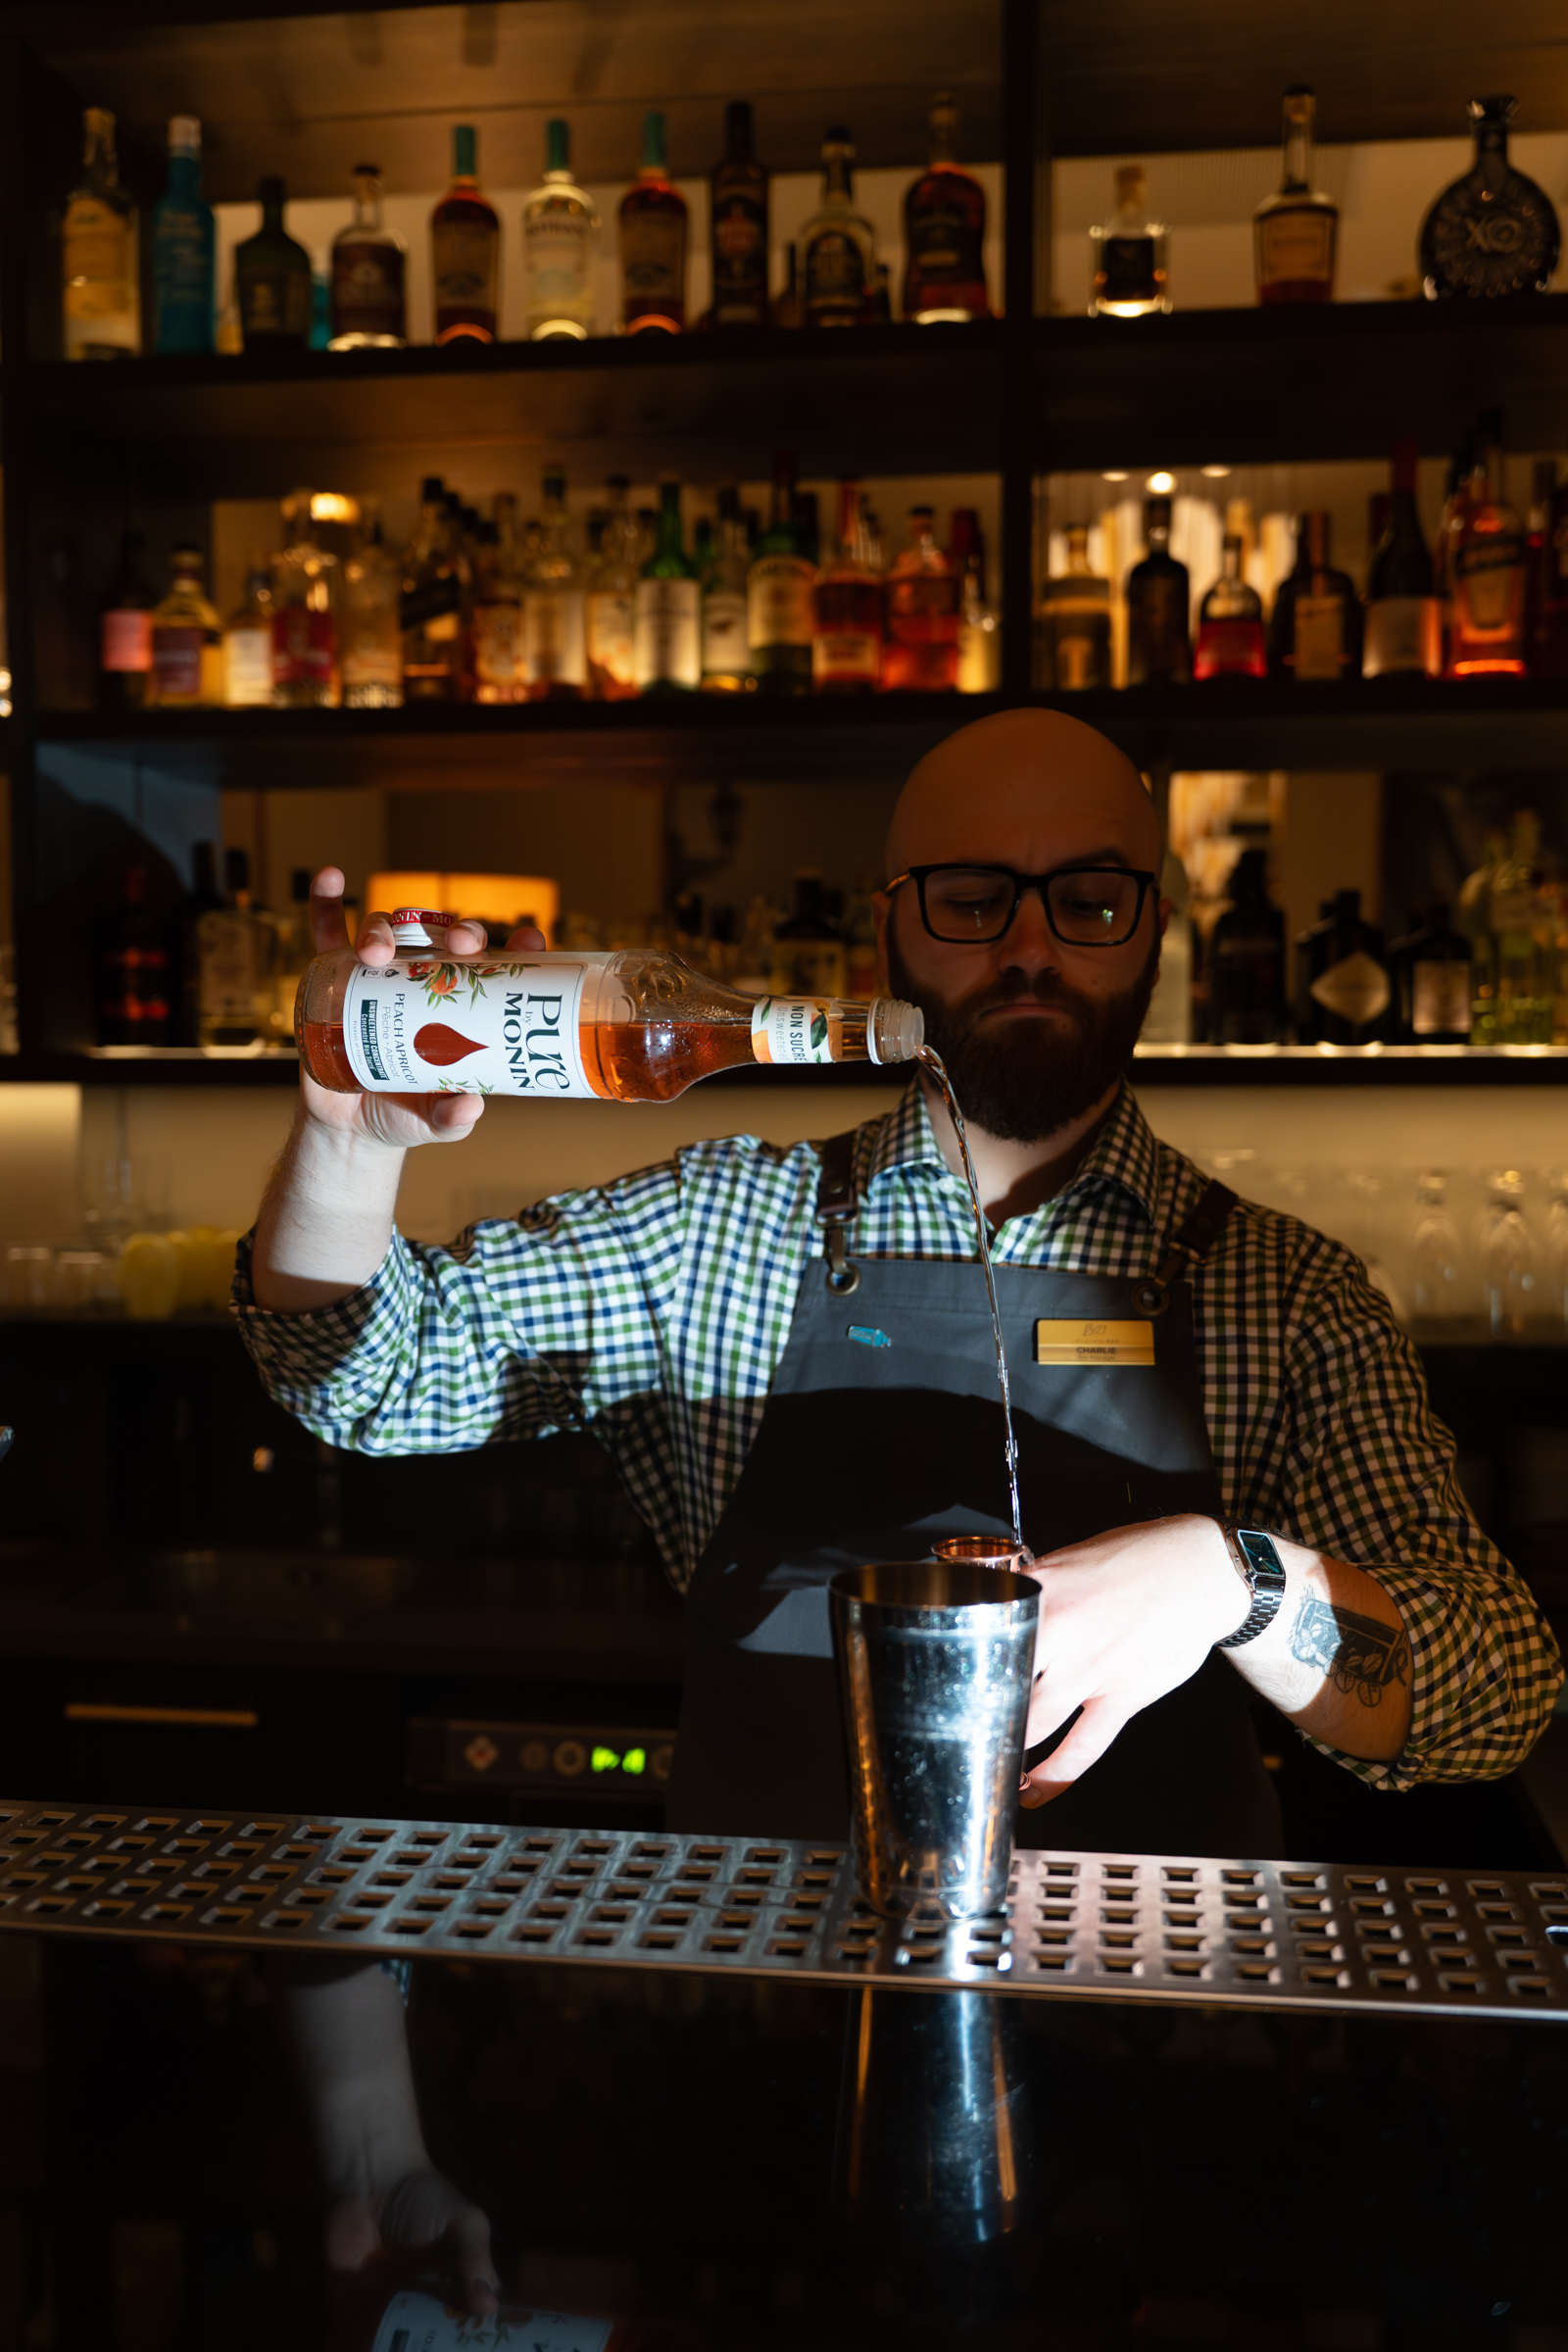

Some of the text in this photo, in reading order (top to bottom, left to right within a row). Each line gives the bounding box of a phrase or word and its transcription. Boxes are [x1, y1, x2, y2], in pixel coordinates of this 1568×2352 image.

[393, 911, 421, 923] ONIN
[368, 1001, 377, 1045] UNSWEETENED
[381, 1005, 400, 1077] Pêche Abricot
[393, 993, 418, 1085] PEACH APRICOT
[503, 992, 536, 1091] MONIN
[522, 1010, 534, 1025] by
[790, 1005, 808, 1061] NON SUCRÉ
